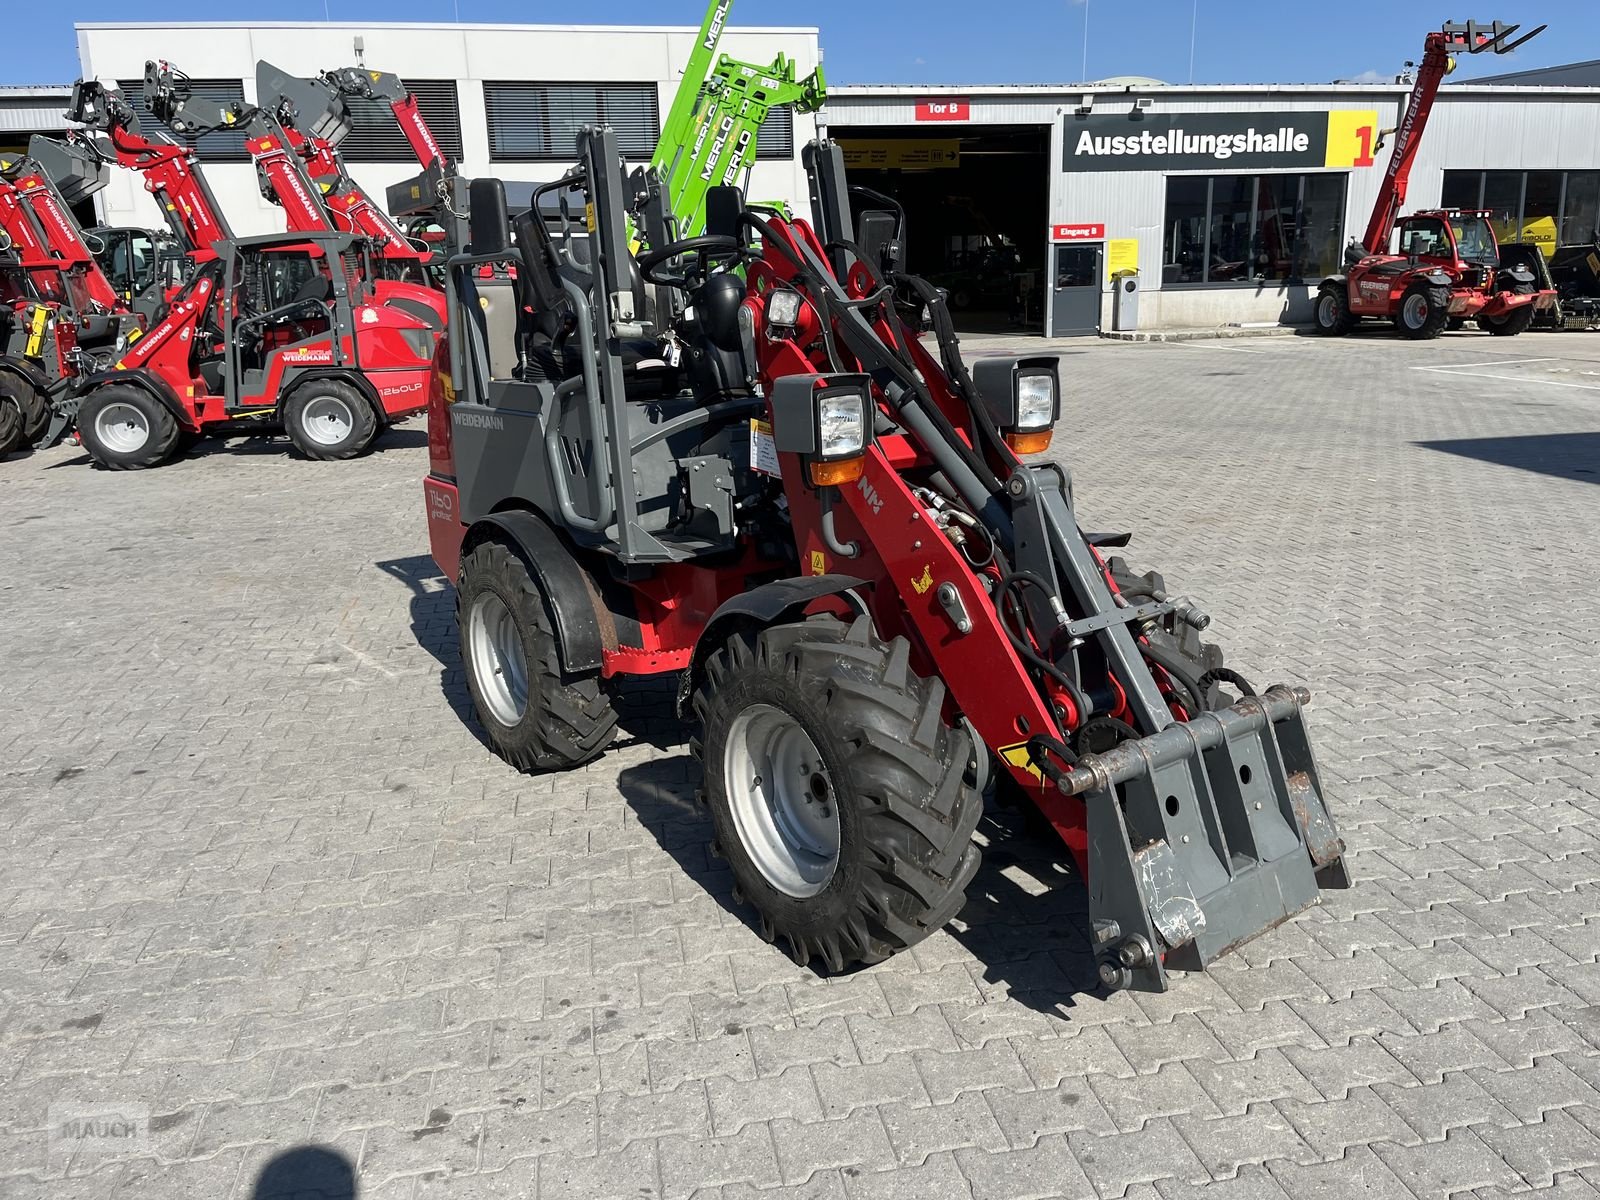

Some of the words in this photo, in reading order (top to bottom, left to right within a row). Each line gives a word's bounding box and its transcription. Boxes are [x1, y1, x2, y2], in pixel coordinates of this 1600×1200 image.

[928, 103, 946, 113] Tor
[949, 103, 958, 113] B
[1075, 127, 1309, 159] Ausstellungshalle
[1353, 126, 1374, 167] 1
[1388, 86, 1424, 177] FEUERWEHR
[701, 117, 734, 180] MERLO
[282, 163, 319, 221] WEIDEMANN
[45, 198, 75, 242] WEIDEMANN
[366, 209, 402, 249] WEIDEMANN
[1060, 227, 1090, 236] Eingang
[1091, 227, 1097, 235] B
[1360, 279, 1389, 292] FEUERWEHR
[136, 323, 173, 356] WEIDEMANN
[282, 354, 331, 362] WEIDEMANN
[379, 382, 423, 397] 1260LP
[453, 412, 504, 431] WEIDEMANN
